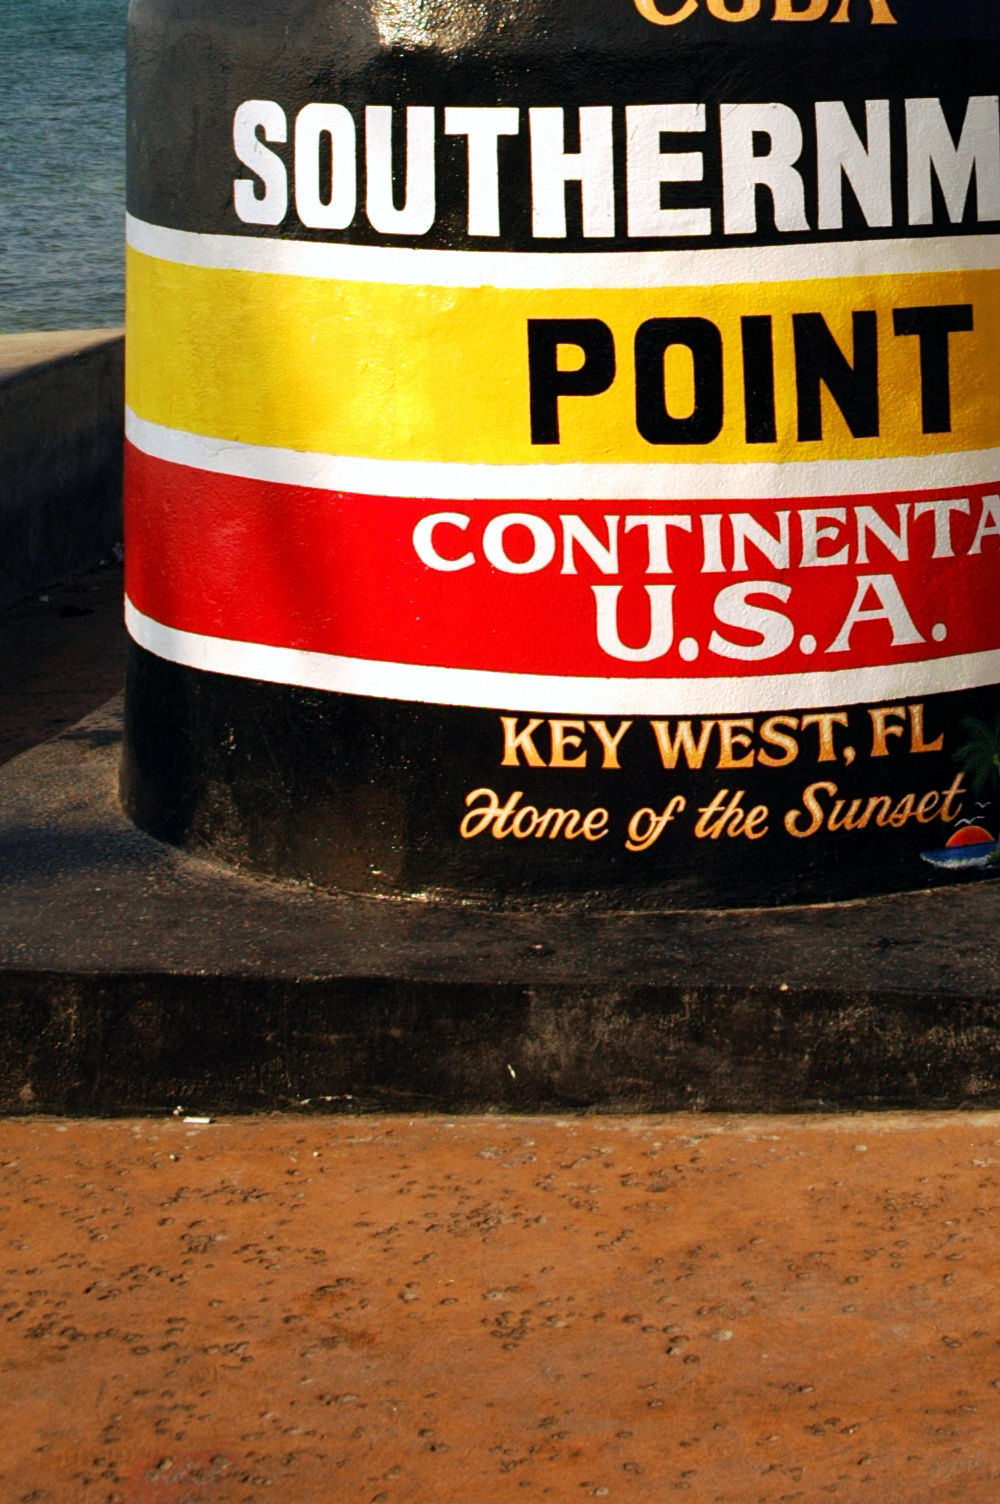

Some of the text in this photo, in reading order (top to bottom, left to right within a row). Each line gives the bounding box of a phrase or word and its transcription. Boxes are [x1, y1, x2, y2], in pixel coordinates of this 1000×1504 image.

[526, 304, 974, 446] POINT
[590, 573, 947, 663] U.S.A.
[500, 704, 944, 770] KEY WEST, FL
[459, 771, 966, 853] Home of the Sunset
